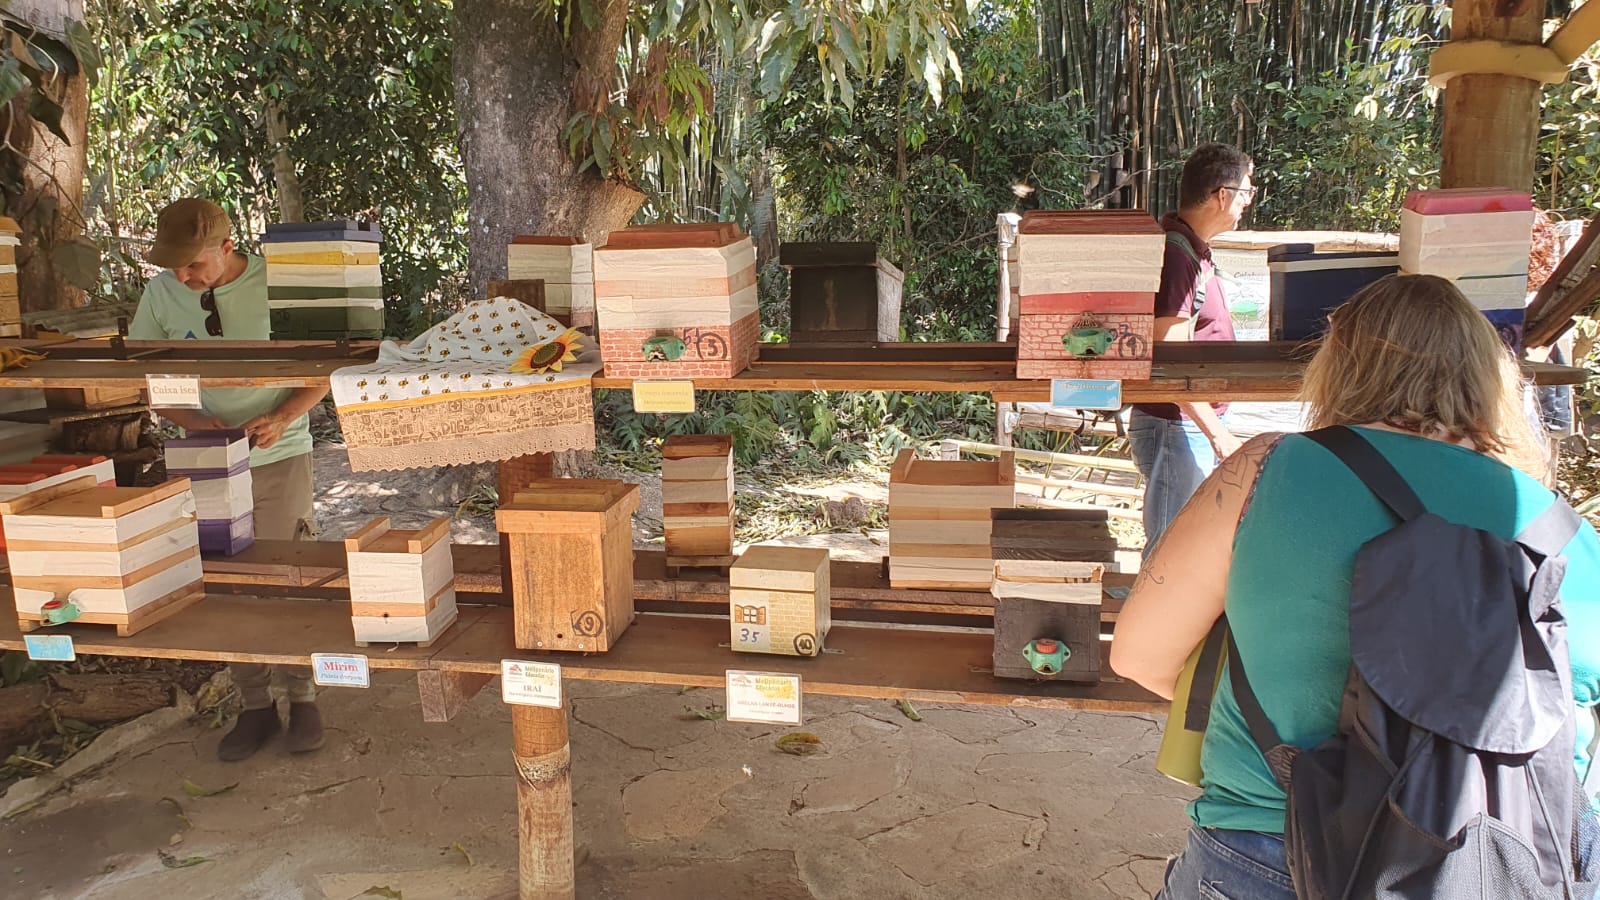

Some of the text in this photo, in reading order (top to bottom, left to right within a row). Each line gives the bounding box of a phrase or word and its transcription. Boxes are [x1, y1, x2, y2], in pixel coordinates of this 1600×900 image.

[707, 338, 719, 357] 3
[152, 385, 178, 394] Caixa
[740, 627, 760, 643] 35
[323, 661, 358, 672] Mirim
